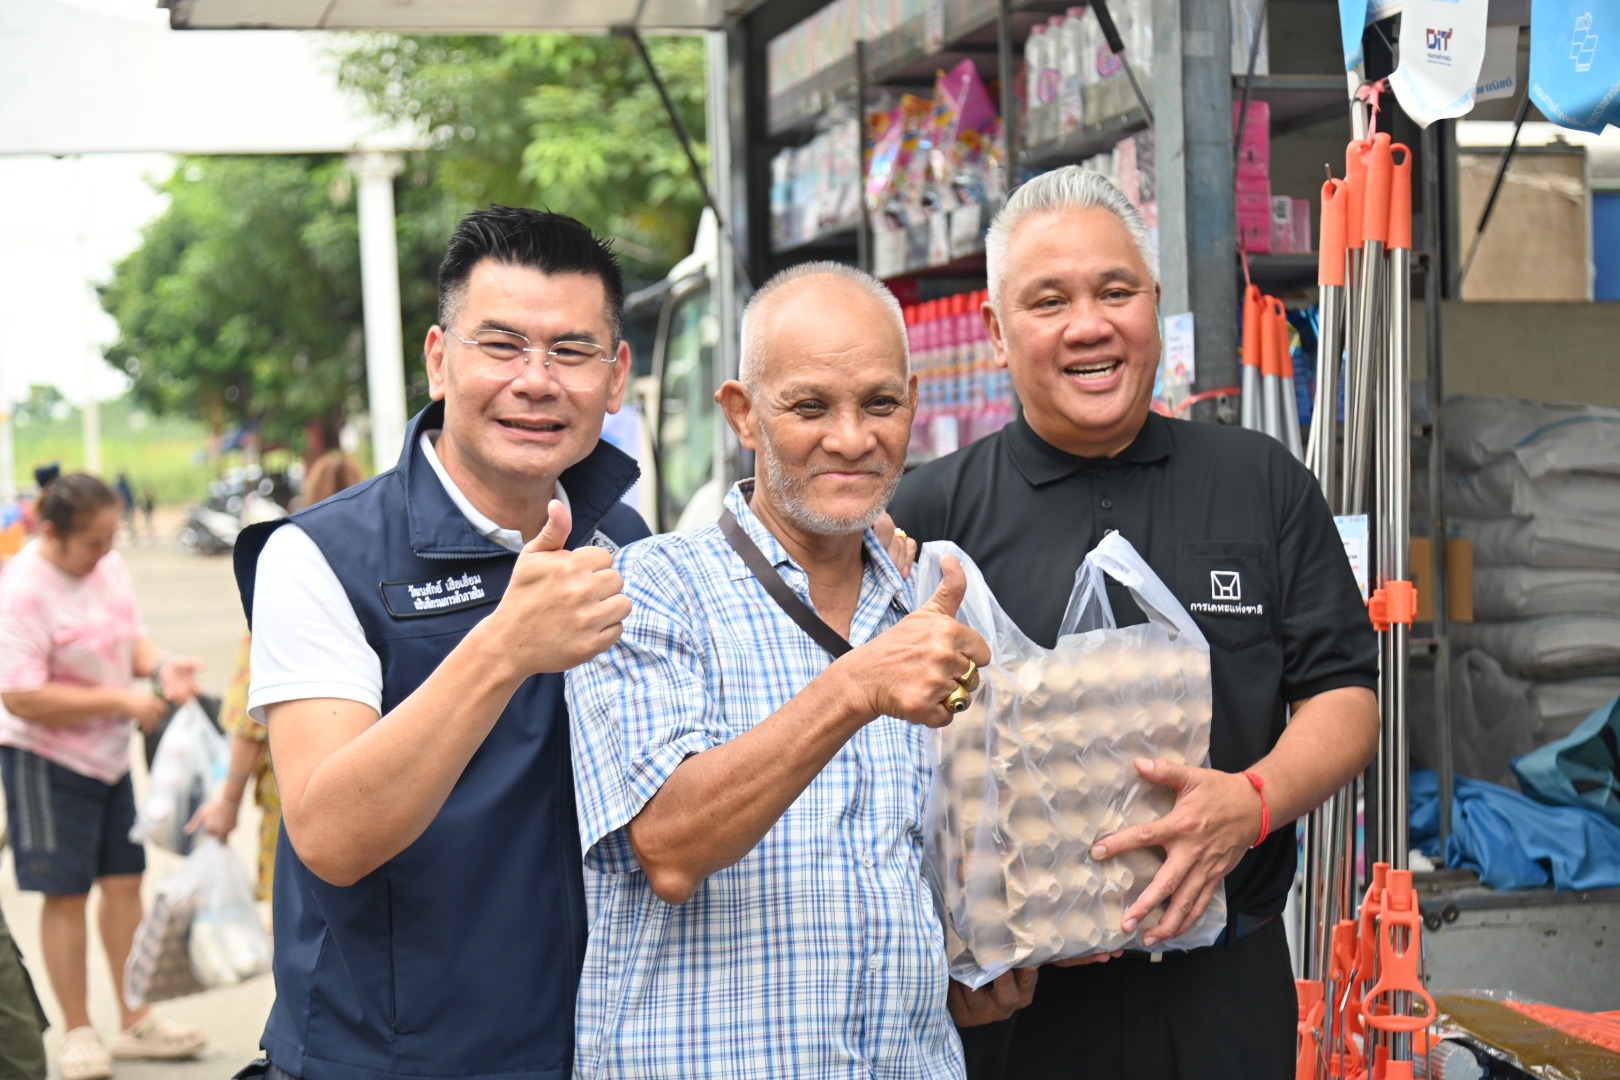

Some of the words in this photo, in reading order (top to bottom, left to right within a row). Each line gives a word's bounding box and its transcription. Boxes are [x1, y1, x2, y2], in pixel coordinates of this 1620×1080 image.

[1190, 601, 1263, 615] การเคหะแห่งชาติ
